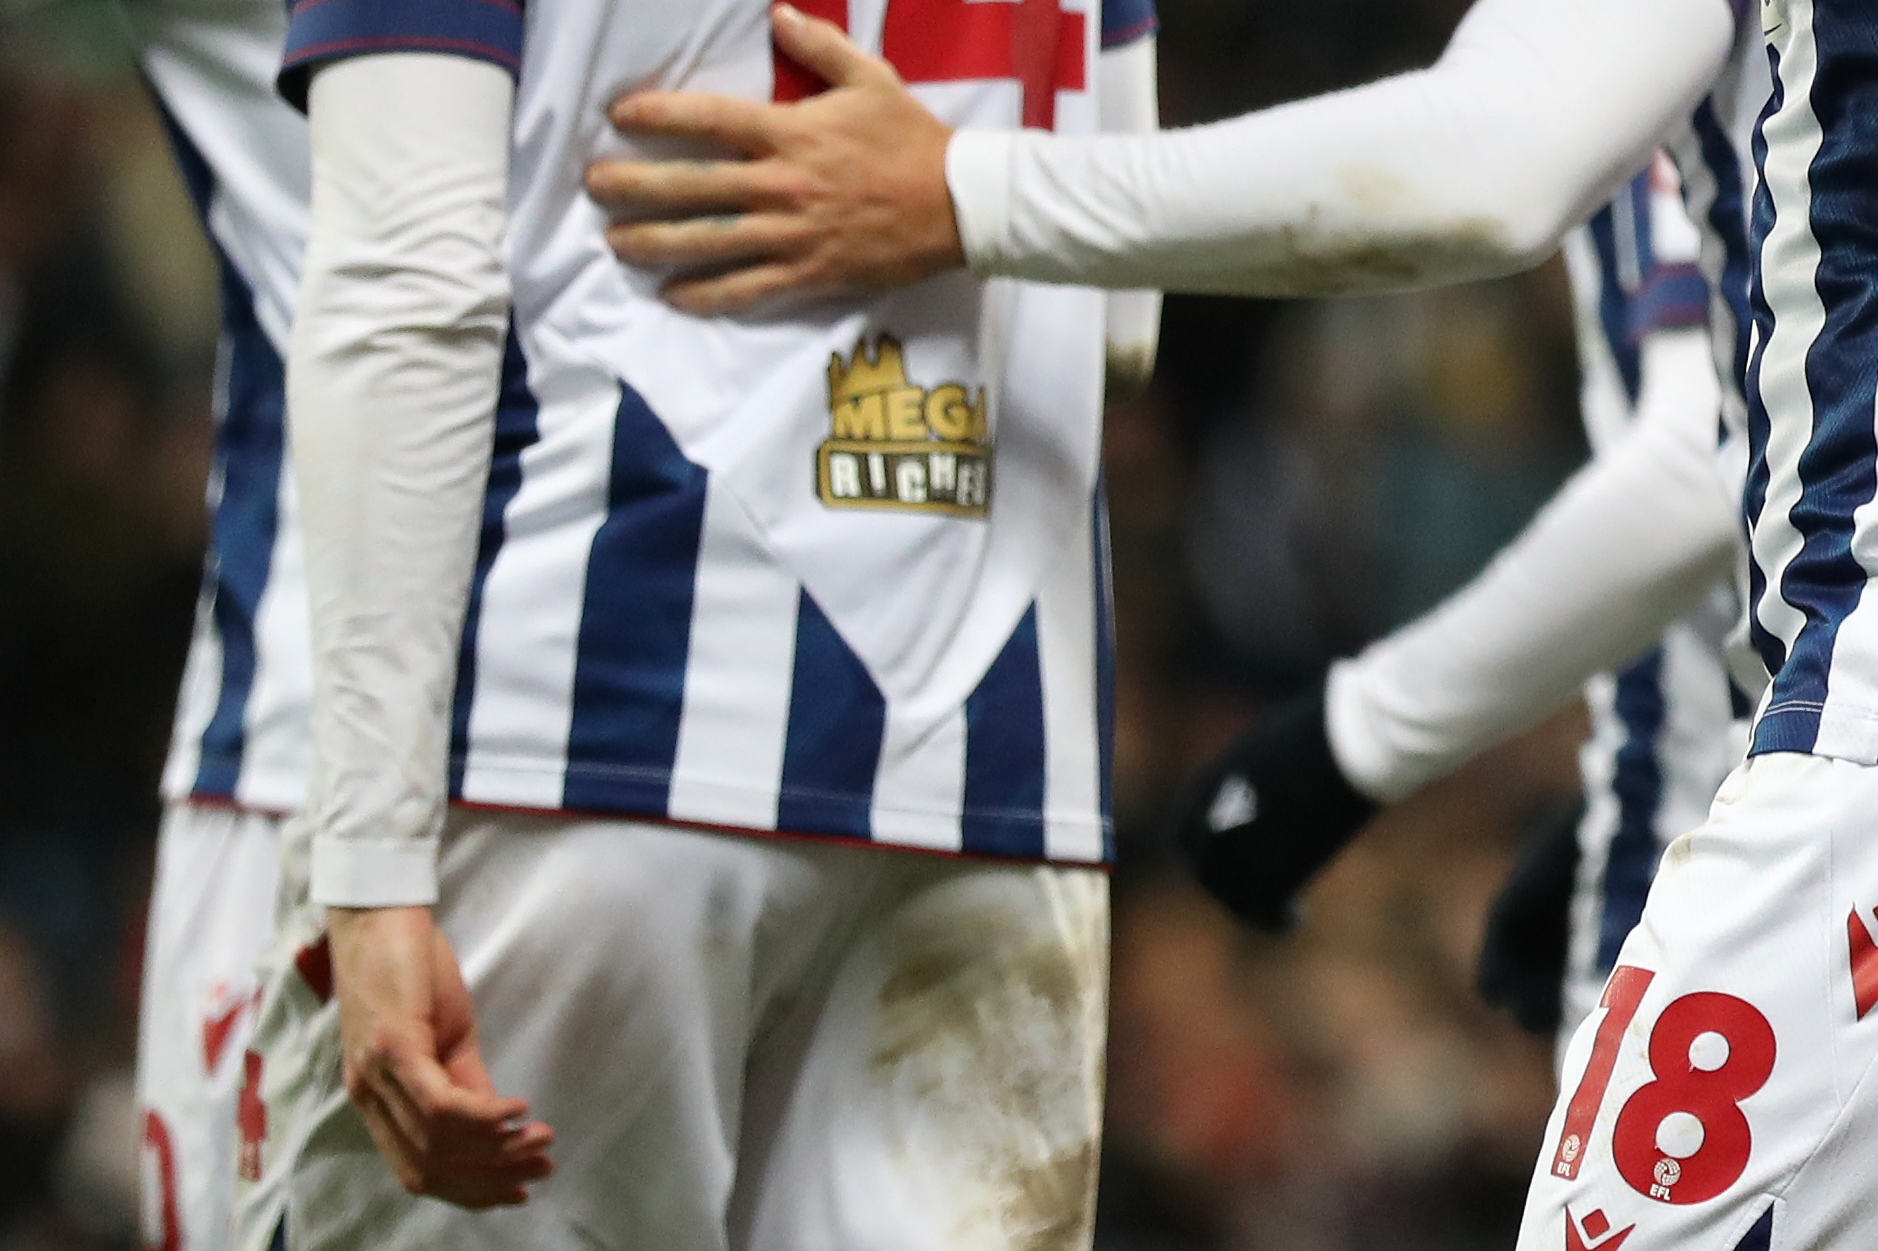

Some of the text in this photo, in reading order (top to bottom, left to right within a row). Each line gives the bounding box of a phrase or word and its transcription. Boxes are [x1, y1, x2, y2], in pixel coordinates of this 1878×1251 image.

[1550, 964, 1777, 1205] 18
[1556, 1161, 1573, 1177] EFL
[1649, 1183, 1672, 1201] EFL
